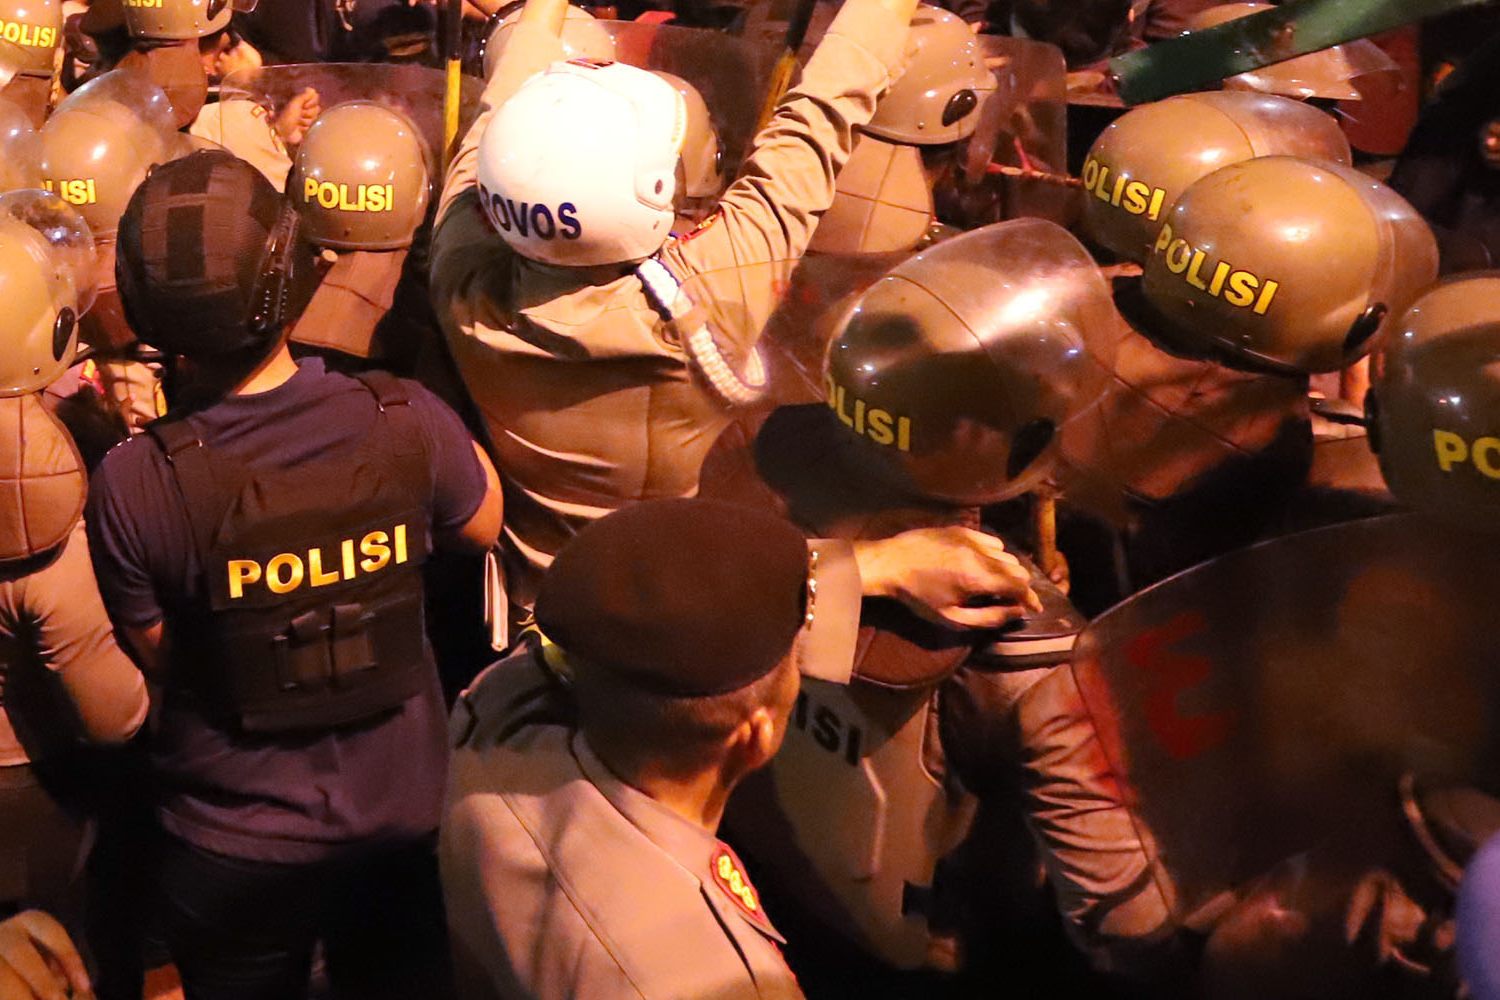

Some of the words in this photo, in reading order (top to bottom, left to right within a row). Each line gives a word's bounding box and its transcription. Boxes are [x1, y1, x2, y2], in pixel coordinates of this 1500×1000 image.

[304, 177, 393, 212] POLISI
[1154, 223, 1279, 316] POLISI
[228, 524, 408, 599] POLISI
